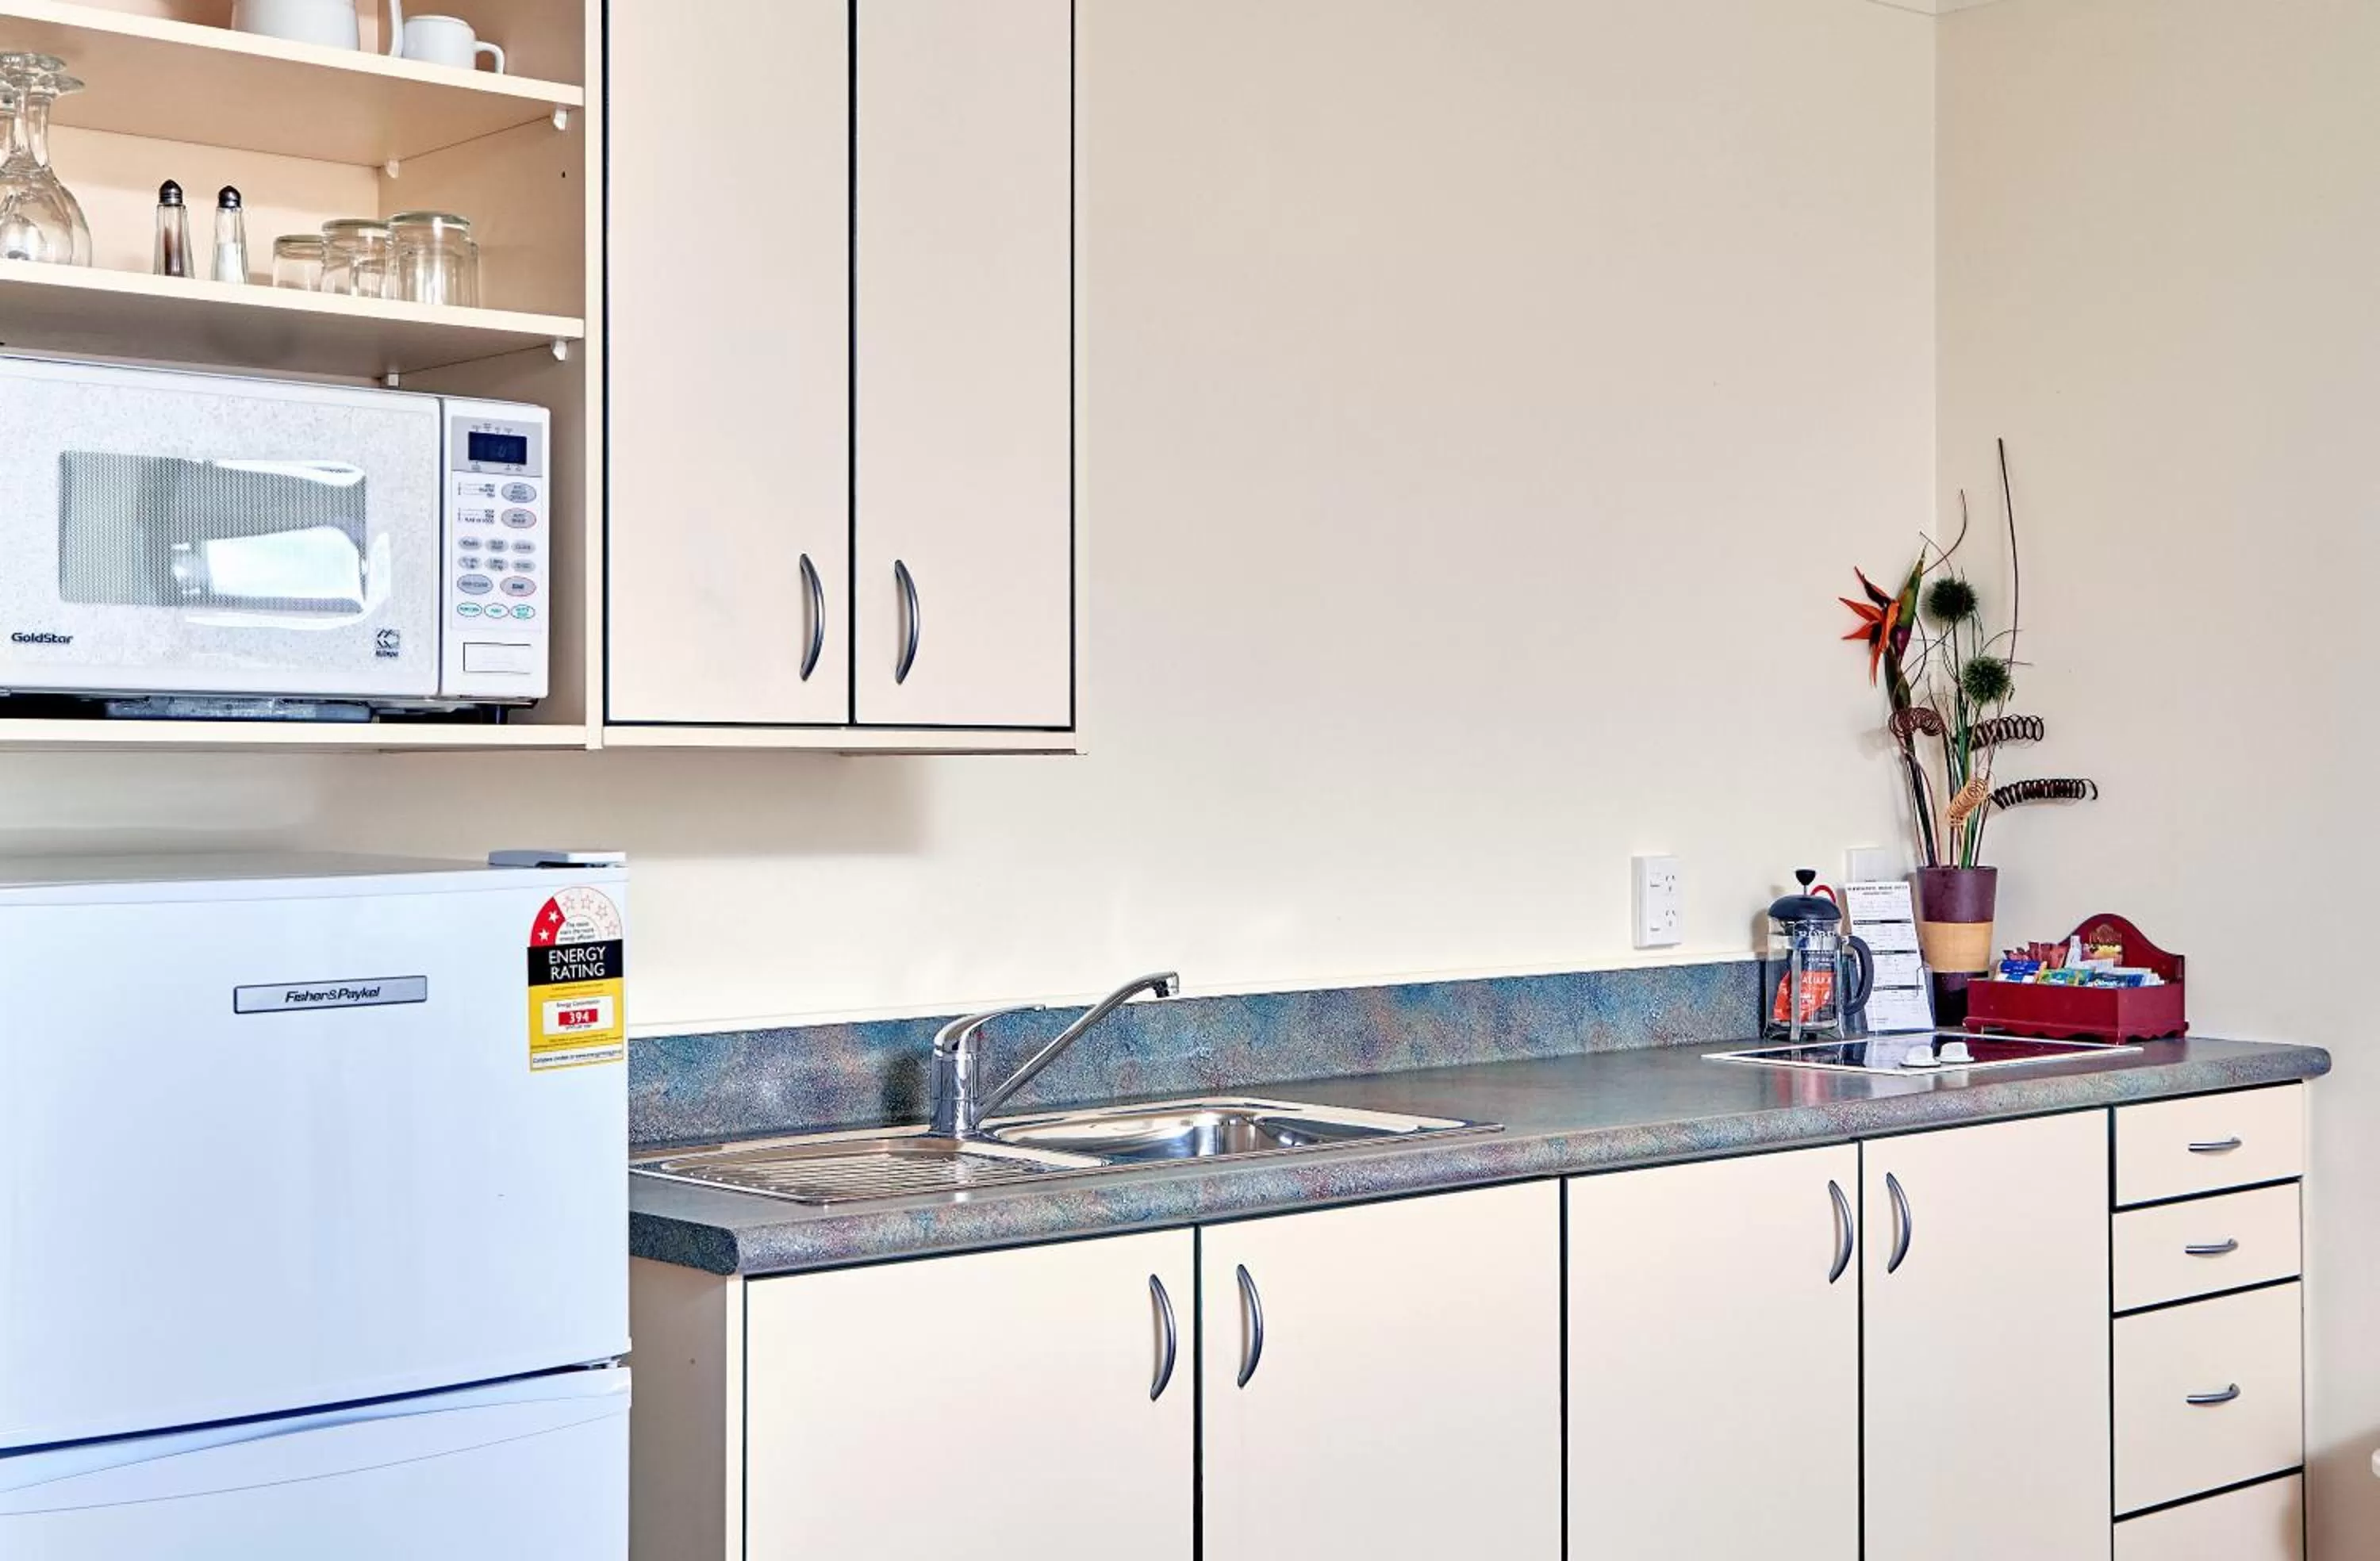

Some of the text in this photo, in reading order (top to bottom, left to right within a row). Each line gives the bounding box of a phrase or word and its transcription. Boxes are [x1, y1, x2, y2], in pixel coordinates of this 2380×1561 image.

[10, 632, 74, 644] GoldStar
[548, 946, 606, 965] ENERGY
[551, 963, 605, 981] RATING
[568, 1011, 590, 1024] 394
